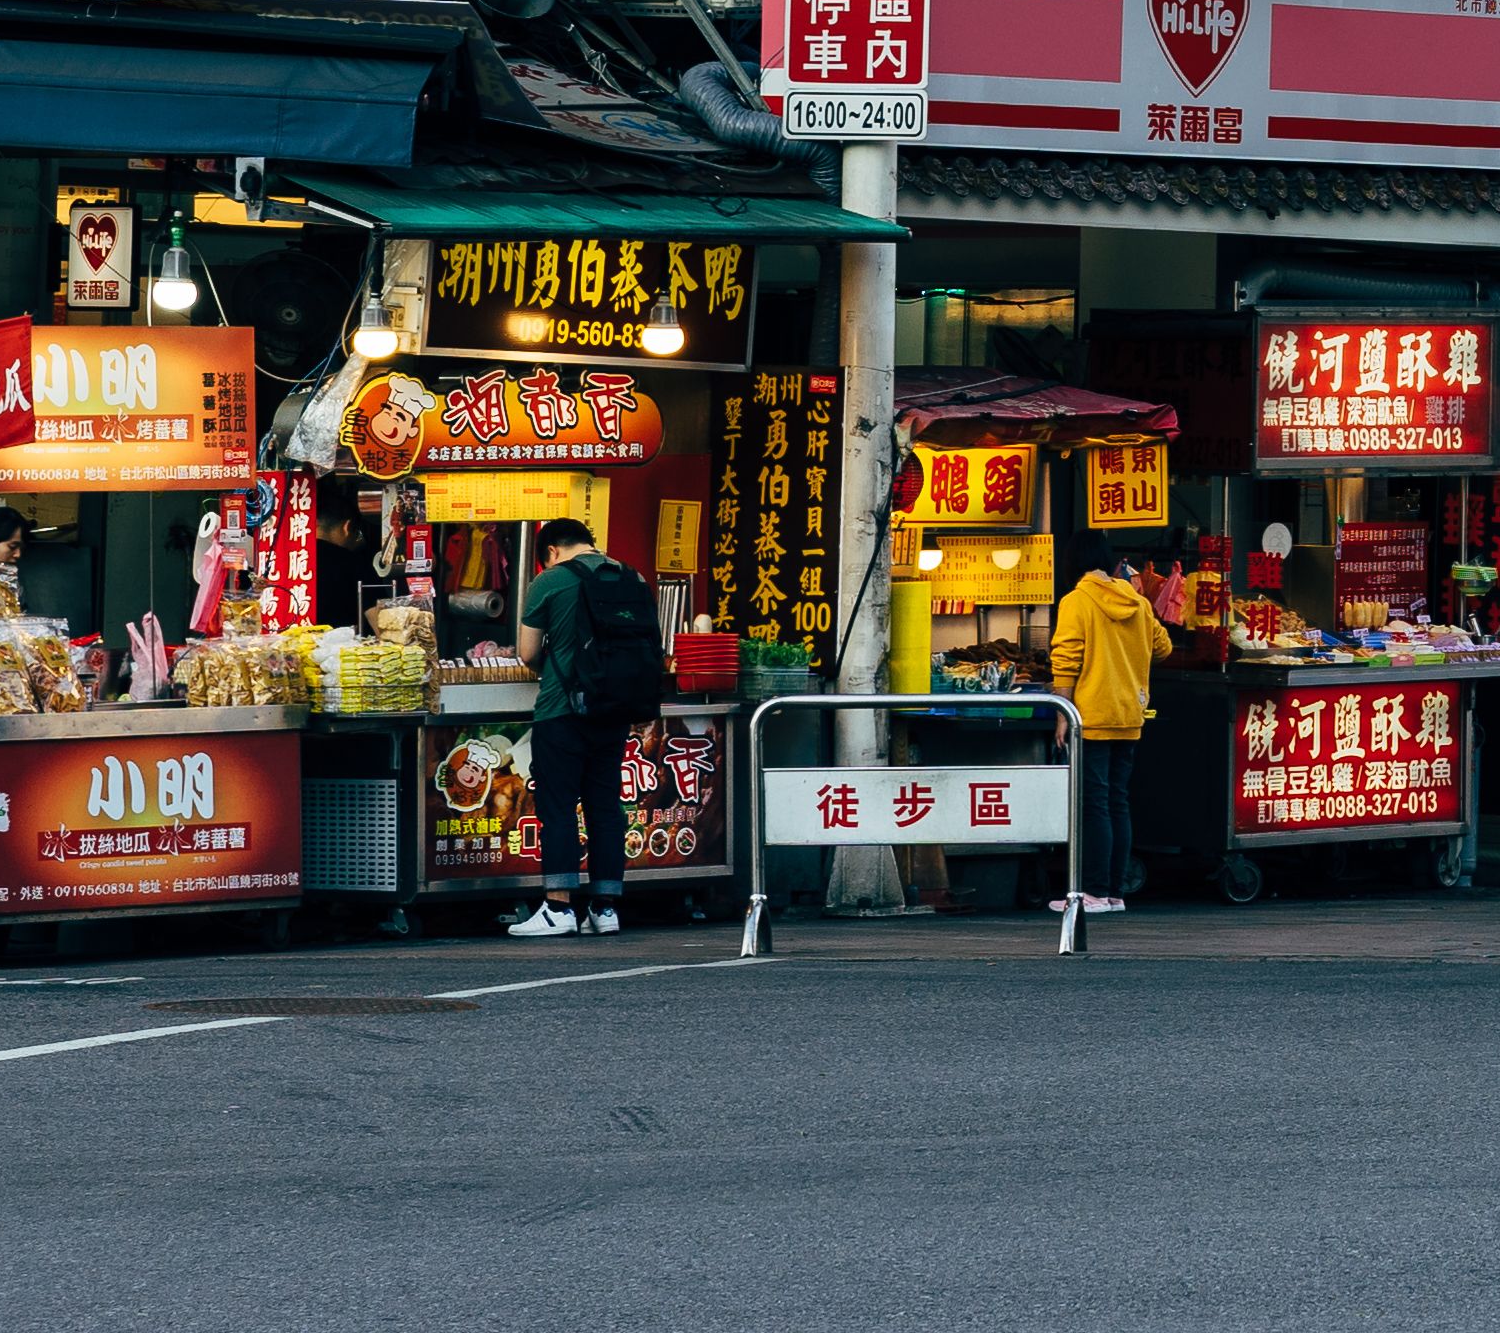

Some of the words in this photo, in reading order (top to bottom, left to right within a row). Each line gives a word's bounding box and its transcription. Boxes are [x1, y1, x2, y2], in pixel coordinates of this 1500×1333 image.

[792, 99, 917, 130] 16:00~24:00
[1146, 102, 1243, 147] 萊爾富
[73, 280, 120, 302] 萊爾富
[438, 238, 744, 321] 潮州勇伯蒸茶鴨
[33, 343, 158, 411] 小明
[752, 373, 803, 407] 潮州
[1262, 328, 1483, 396] 饒河鹽酥雞
[217, 372, 233, 433] 冰烤地瓜
[232, 372, 247, 433] 拔絲地瓜
[443, 369, 638, 443] 滷都香
[930, 454, 1023, 515] 鴨頭
[1098, 446, 1126, 515] 鴨頭
[1131, 446, 1157, 514] 東山
[711, 395, 744, 639] 墾丁大街必吃美
[1242, 690, 1454, 763] 饒河鹽酥雞
[87, 750, 216, 822] 小明
[816, 781, 1012, 830] 徒步區
[79, 831, 151, 857] 拔絲地瓜
